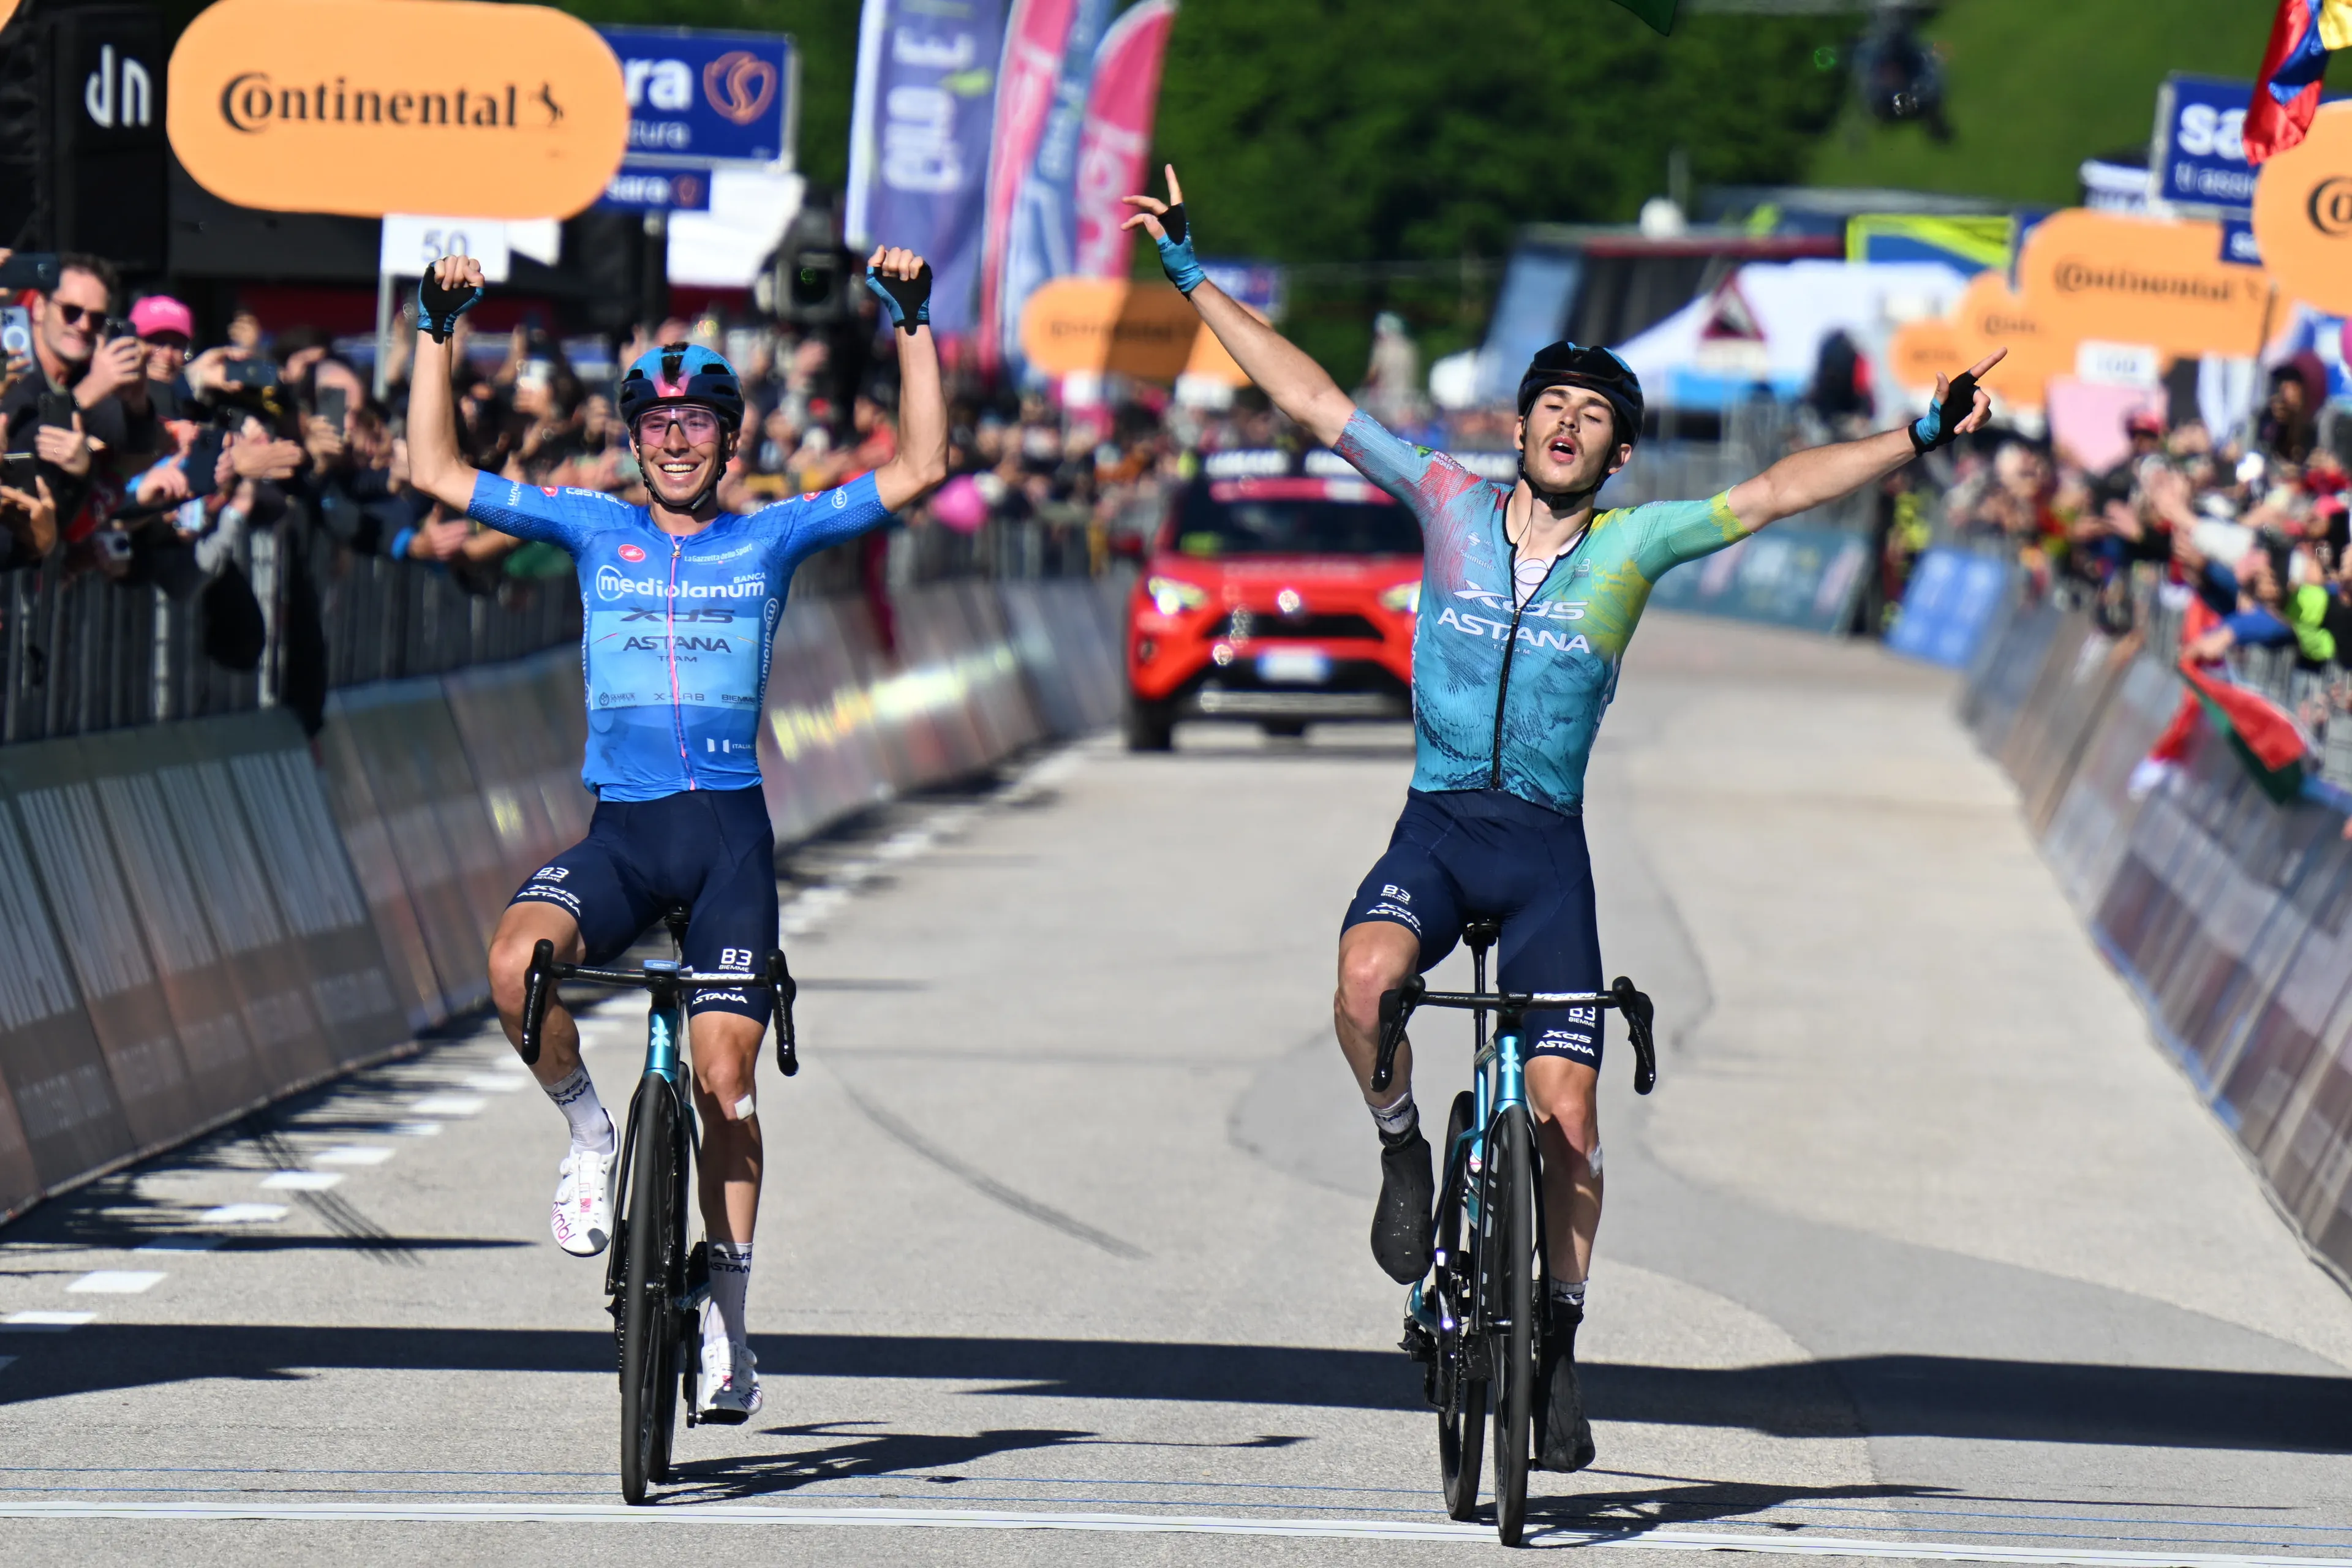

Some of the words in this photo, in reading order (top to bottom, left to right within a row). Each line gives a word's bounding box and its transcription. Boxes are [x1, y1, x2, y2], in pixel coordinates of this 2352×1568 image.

[221, 70, 516, 133] Continental
[421, 230, 470, 265] 50
[1433, 456, 1453, 470] BROKER
[1434, 451, 1472, 475] FREE
[735, 543, 752, 557] Sport
[1460, 549, 1494, 571] SHIMANO
[598, 573, 766, 598] mediolanum
[733, 572, 766, 584] BANCA
[1437, 606, 1591, 654] ASTANA
[623, 635, 732, 654] ASTANA
[1493, 644, 1531, 655] TEAM
[536, 867, 570, 879] B3
[1381, 893, 1409, 905] BIEMME
[1382, 884, 1411, 902] B3
[516, 891, 581, 918] ASTANA
[1366, 909, 1422, 938] ASTANA
[721, 948, 752, 966] B3
[718, 964, 750, 973] BIEMME
[1568, 1016, 1596, 1028] BIEMME
[1536, 1040, 1595, 1057] ASTANA
